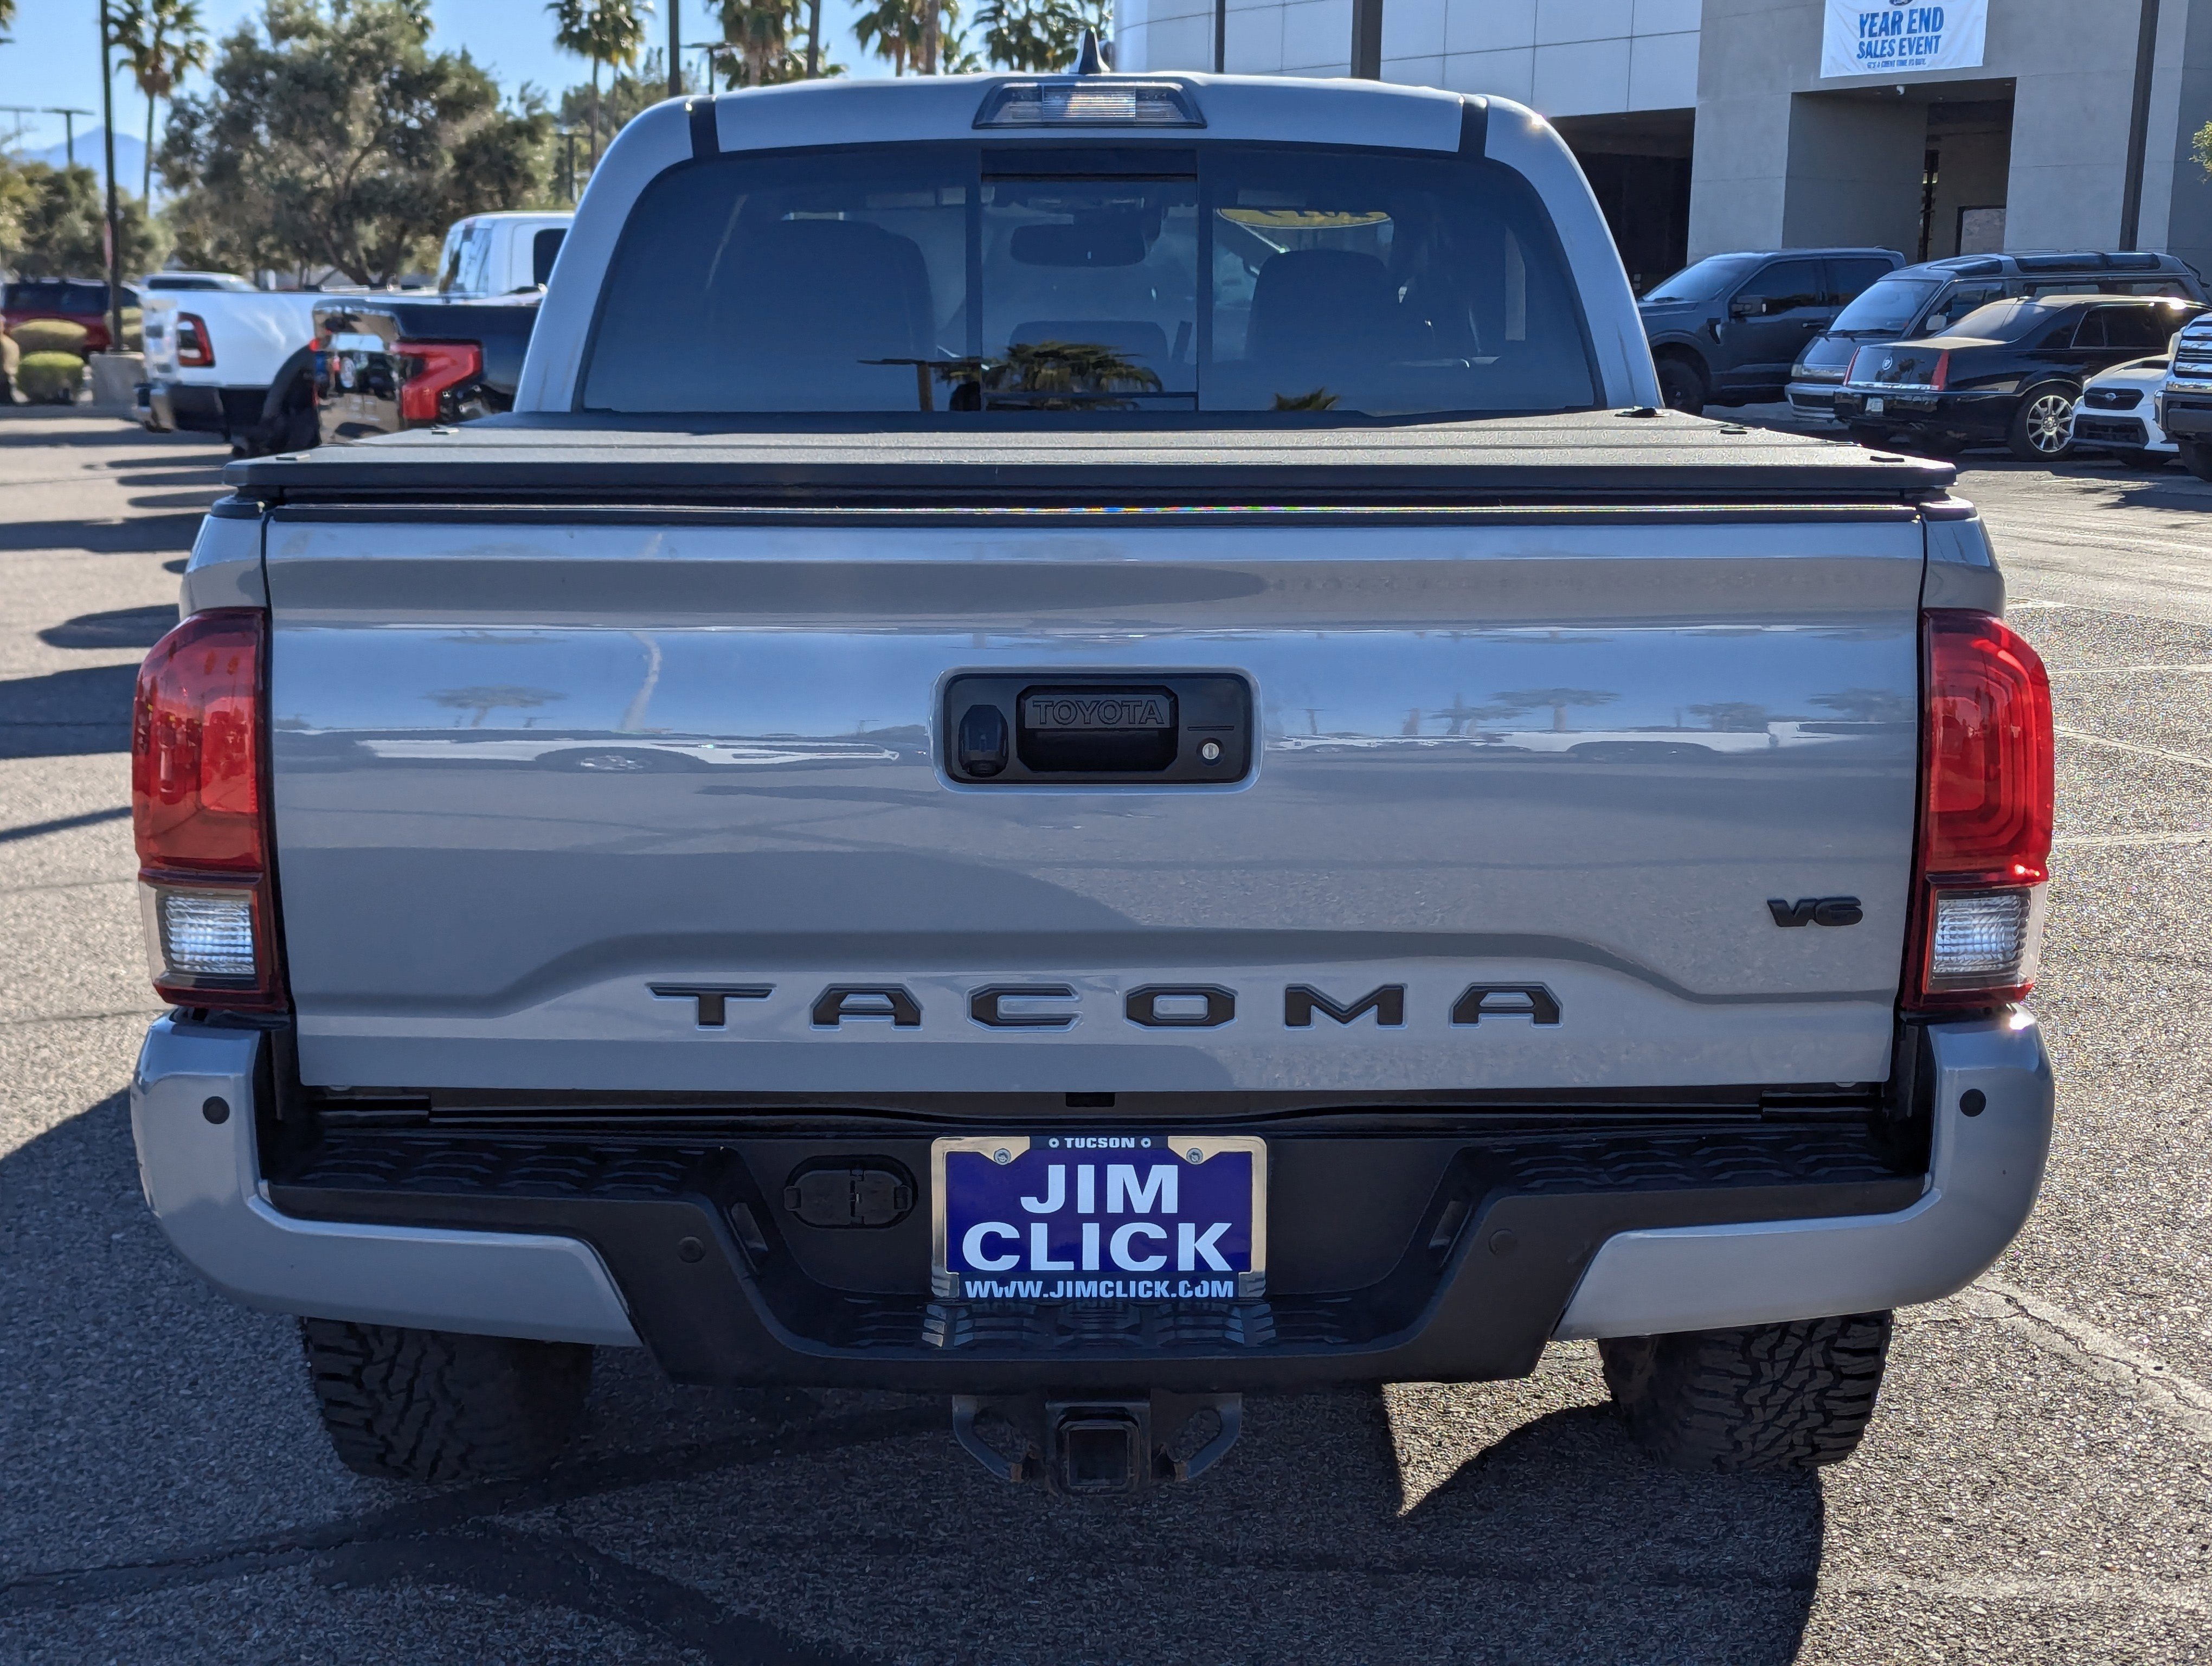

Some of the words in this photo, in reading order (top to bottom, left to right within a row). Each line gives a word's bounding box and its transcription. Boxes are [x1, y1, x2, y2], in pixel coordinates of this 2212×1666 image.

[1859, 10, 1904, 39] YEAR
[1906, 7, 1944, 35] END
[1856, 39, 1896, 60] SALES
[1899, 35, 1942, 56] EVENT
[1032, 699, 1165, 725] TOYOTA
[1766, 895, 1863, 928] V6
[646, 982, 1564, 1030] TACOMA
[1064, 1137, 1135, 1149] TUCSON
[1020, 1164, 1179, 1214] JIM
[962, 1221, 1233, 1272] CLICK
[964, 1280, 1234, 1298] WWW.JIMCLICK.COM
